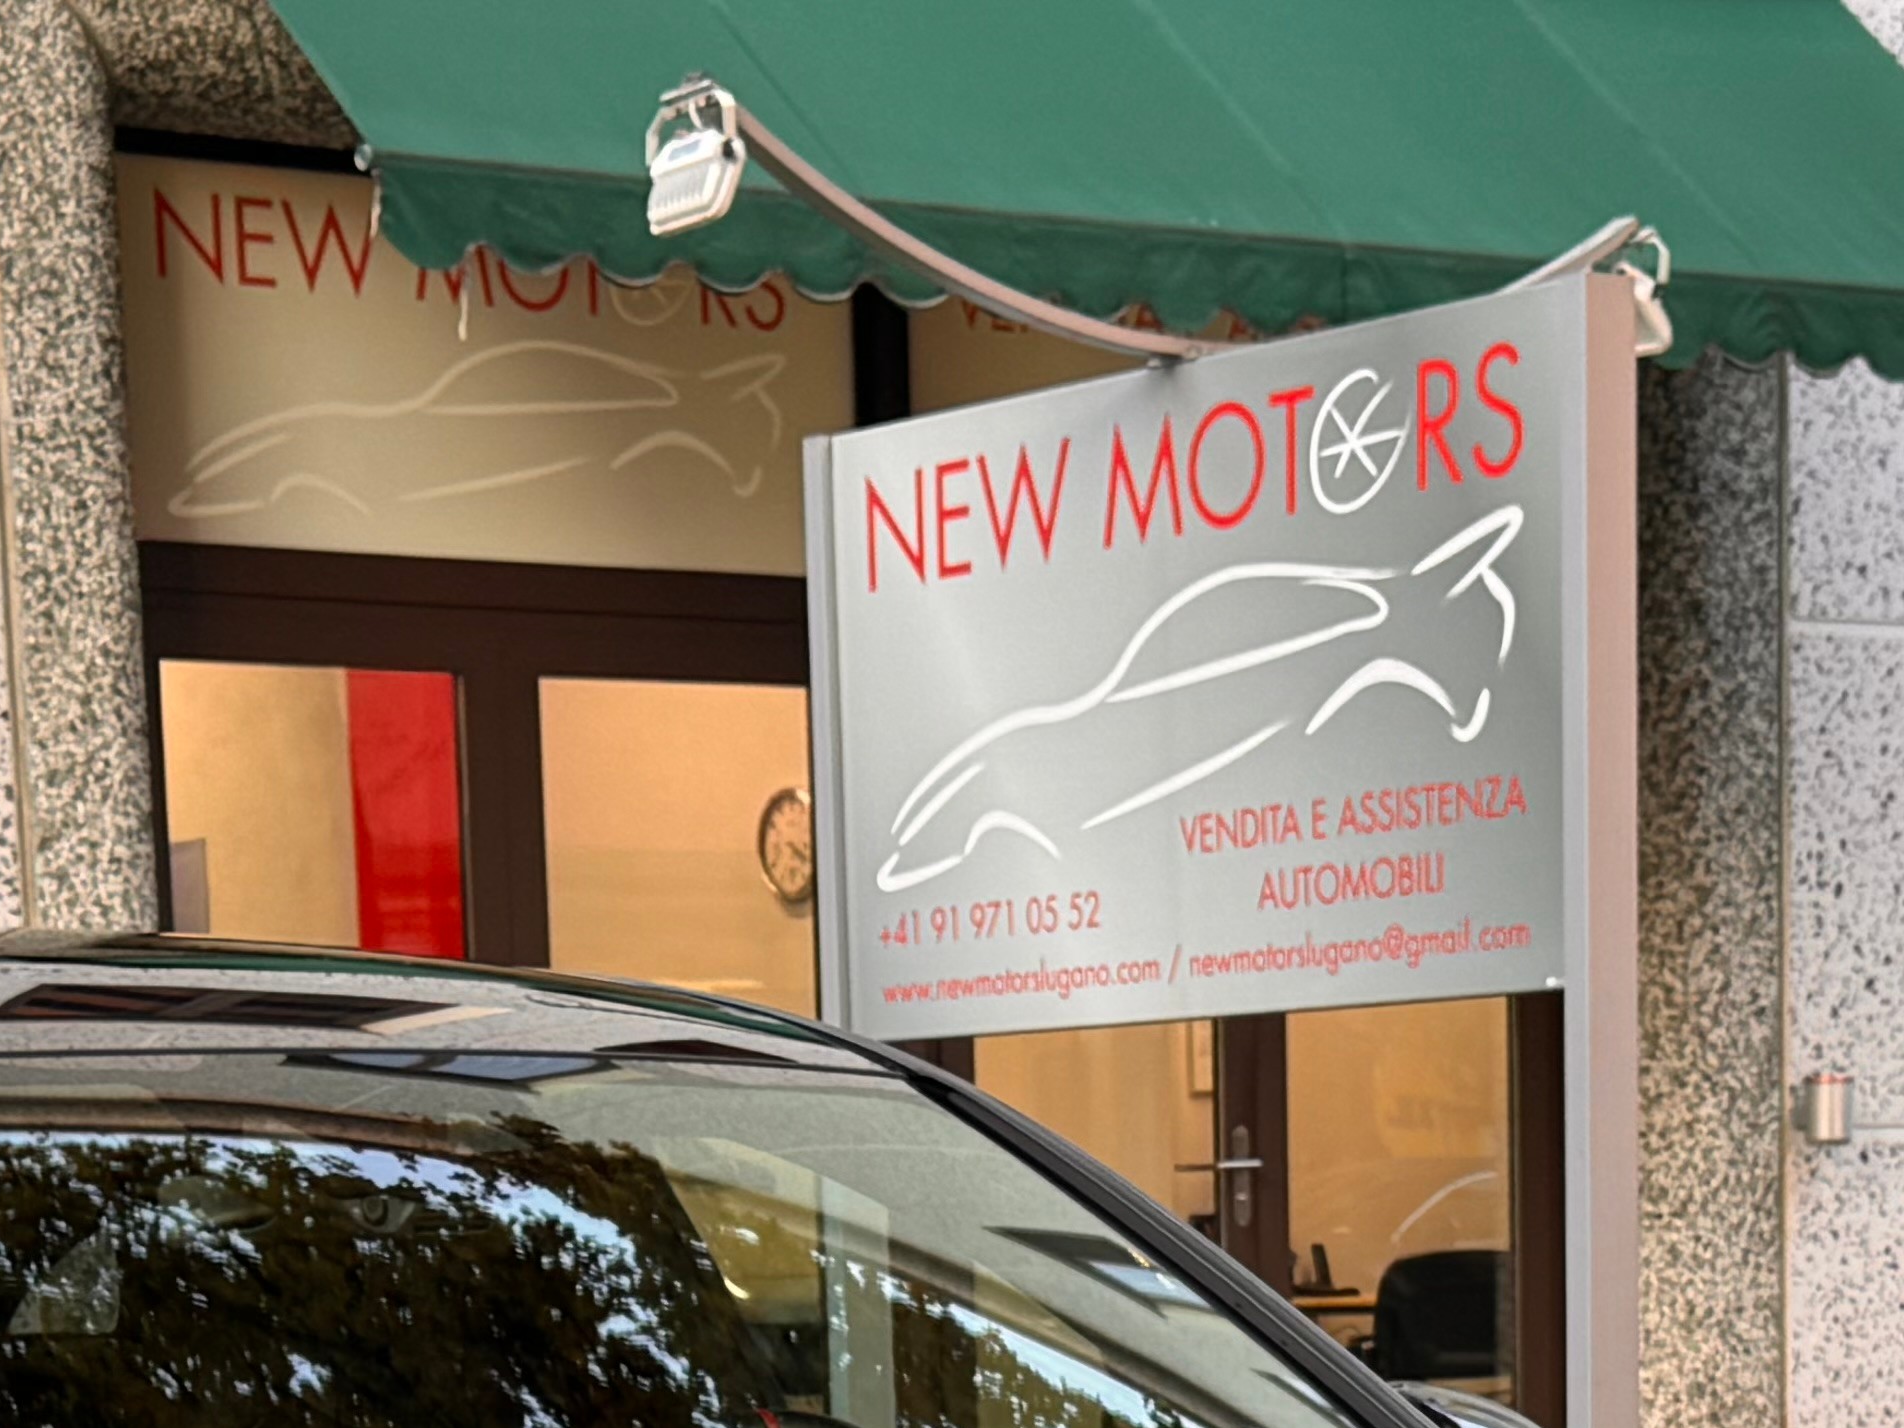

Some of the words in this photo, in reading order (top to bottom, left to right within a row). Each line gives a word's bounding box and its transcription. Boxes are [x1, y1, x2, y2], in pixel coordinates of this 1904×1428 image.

[153, 187, 375, 299] NEW
[864, 435, 1071, 593] NEW
[1179, 802, 1303, 855] VENDITA
[1311, 796, 1328, 841] E
[1337, 772, 1529, 837] ASSISTENZA
[880, 908, 922, 947] +41
[929, 904, 960, 943] 91
[969, 898, 1016, 940] 971
[1025, 894, 1059, 935] 05
[1067, 890, 1102, 932] 52
[1257, 851, 1446, 912] AUTOMOBILI
[882, 954, 1161, 1004] www.newmotorslugano.com
[1188, 913, 1532, 977] newmotorslugano@gmail.com
